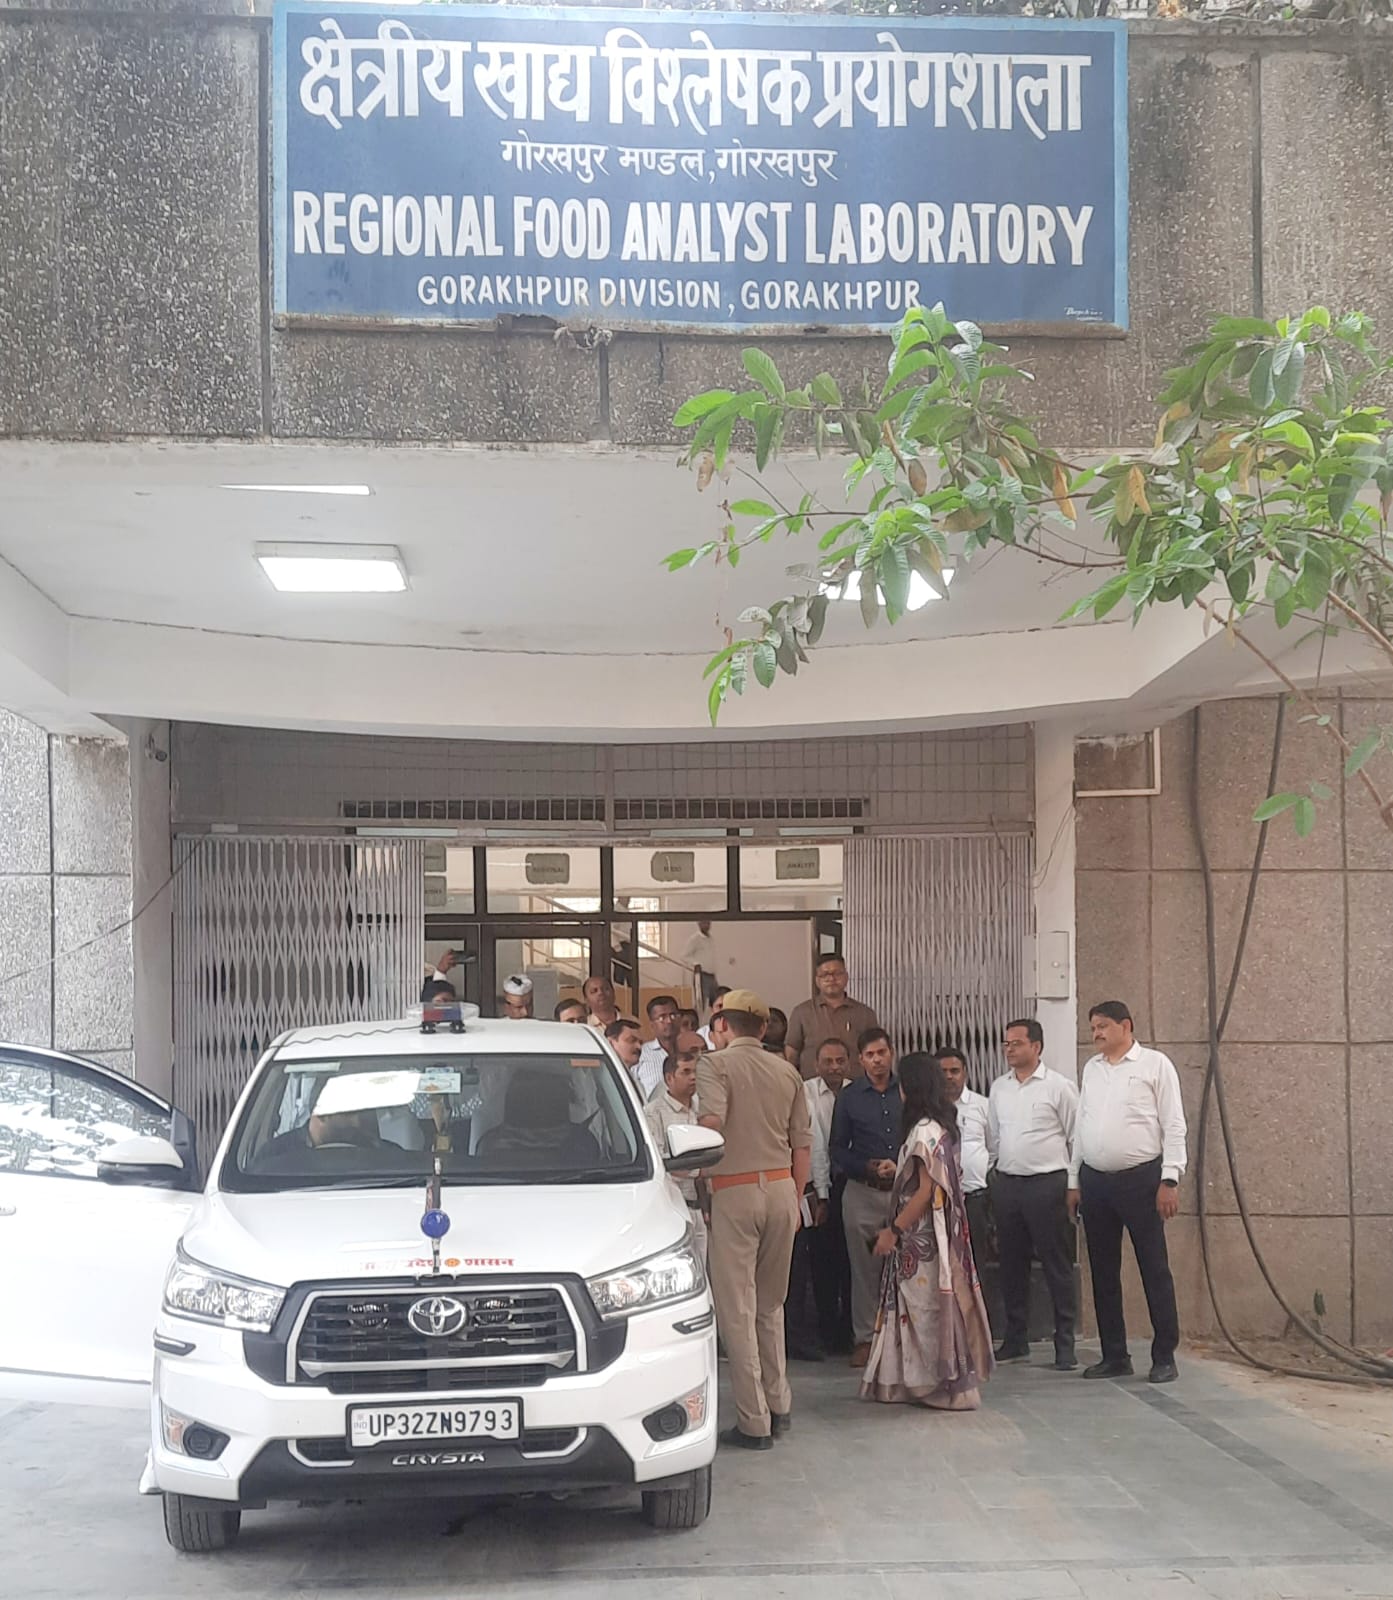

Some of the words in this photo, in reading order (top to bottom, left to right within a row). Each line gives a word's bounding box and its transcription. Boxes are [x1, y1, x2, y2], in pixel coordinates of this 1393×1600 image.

[299, 18, 471, 130] क्षेत्रीय
[473, 42, 597, 123] खाद्य
[600, 28, 811, 135] विश्लेषक
[812, 31, 1092, 140] प्रयोगशाला
[500, 130, 610, 183] गोरखपुर
[714, 138, 838, 187] गोरखपुर
[294, 191, 503, 257] REGIONAL
[514, 196, 611, 260] FOOD
[621, 201, 792, 263] ANALYST
[806, 202, 1094, 265] LABORATORY
[418, 275, 590, 307] GORAKHPUR
[741, 279, 920, 311] GORAKHPUR
[369, 1409, 513, 1437] UP32ZN9793
[392, 1451, 486, 1466] CRYSTA
